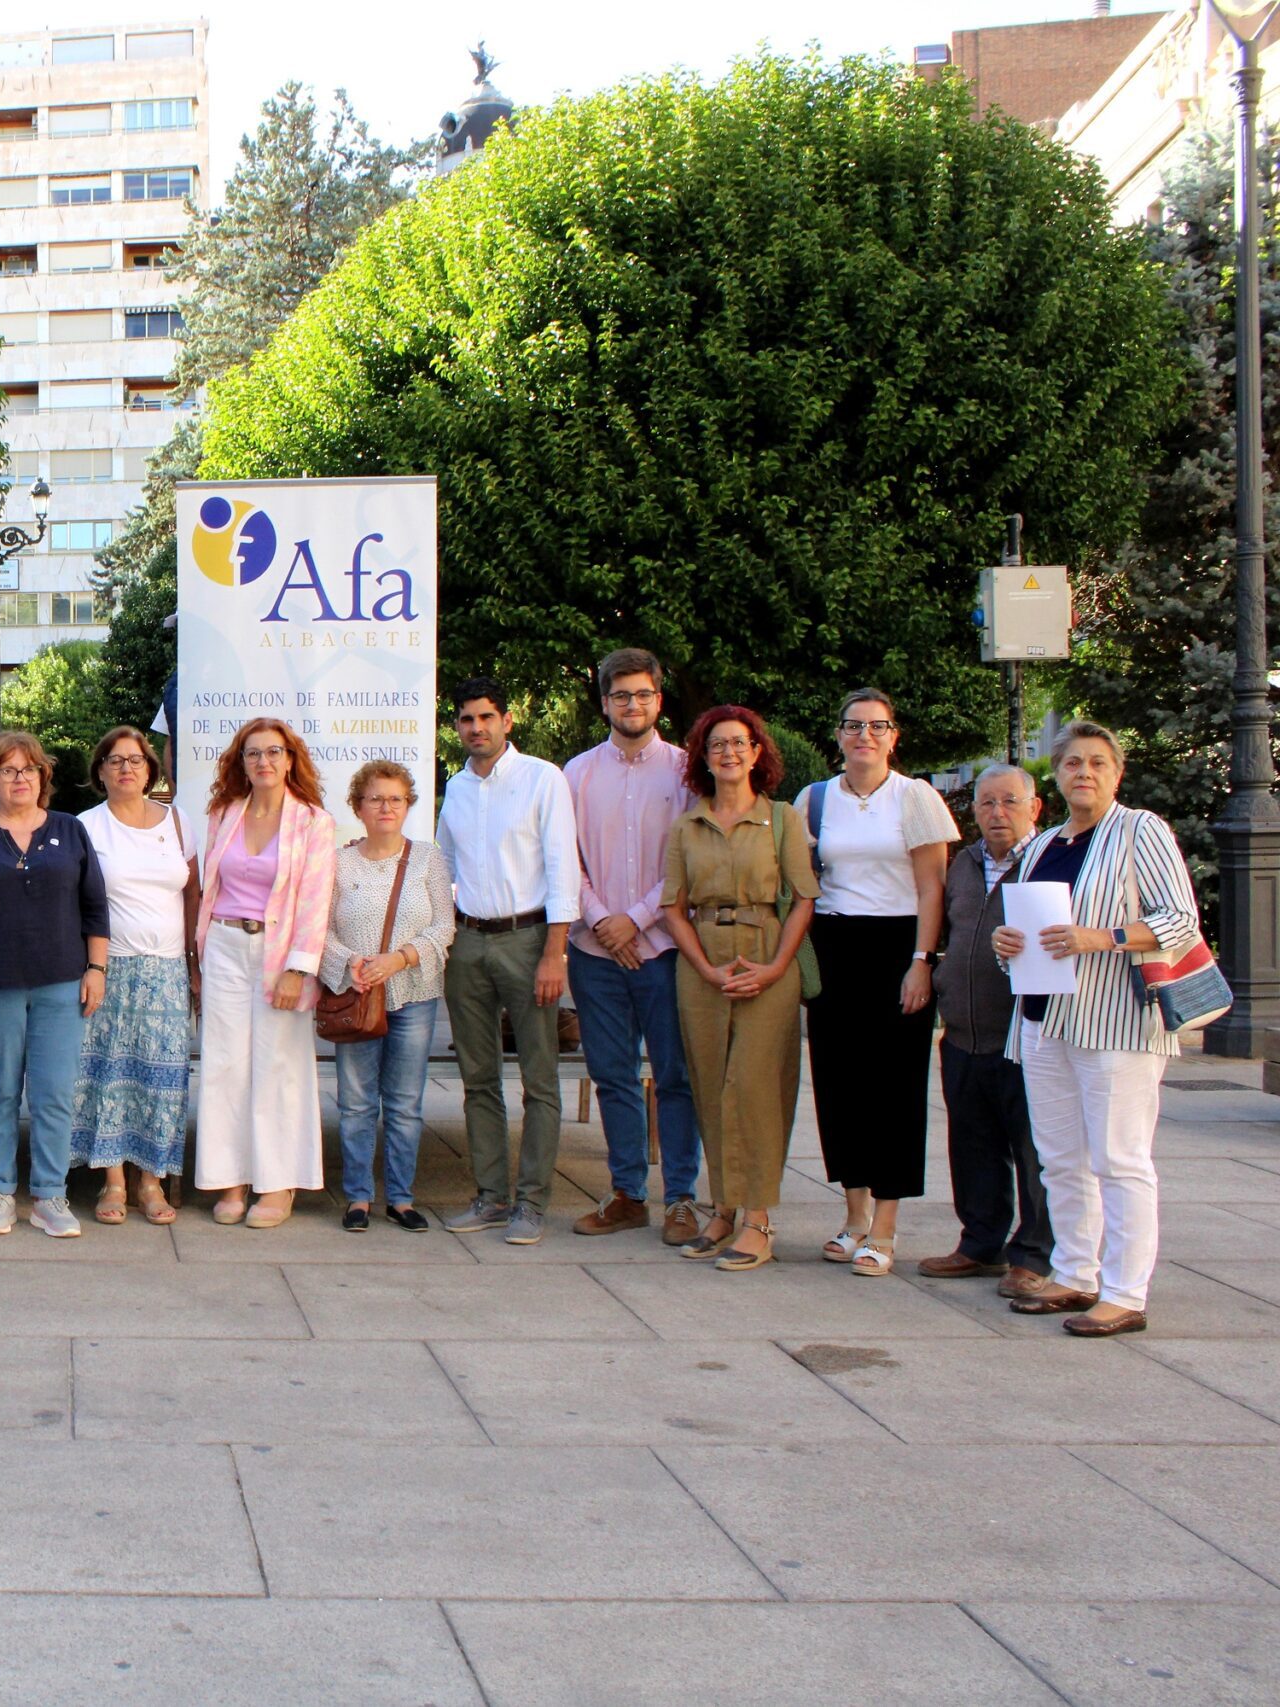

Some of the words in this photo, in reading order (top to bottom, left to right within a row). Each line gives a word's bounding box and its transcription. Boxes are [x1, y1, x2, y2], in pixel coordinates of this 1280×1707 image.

[260, 533, 419, 621] Afa
[260, 632, 421, 647] ALBACETE
[193, 692, 286, 707] ASOCIACION
[296, 692, 316, 707] DE
[327, 692, 419, 707] FAMILIARES
[193, 719, 210, 734] DE
[302, 719, 320, 734] DE
[330, 719, 418, 734] ALZHEIMER
[192, 746, 202, 761] Y
[307, 746, 358, 761] ENCIAS
[361, 746, 418, 761] SENILES
